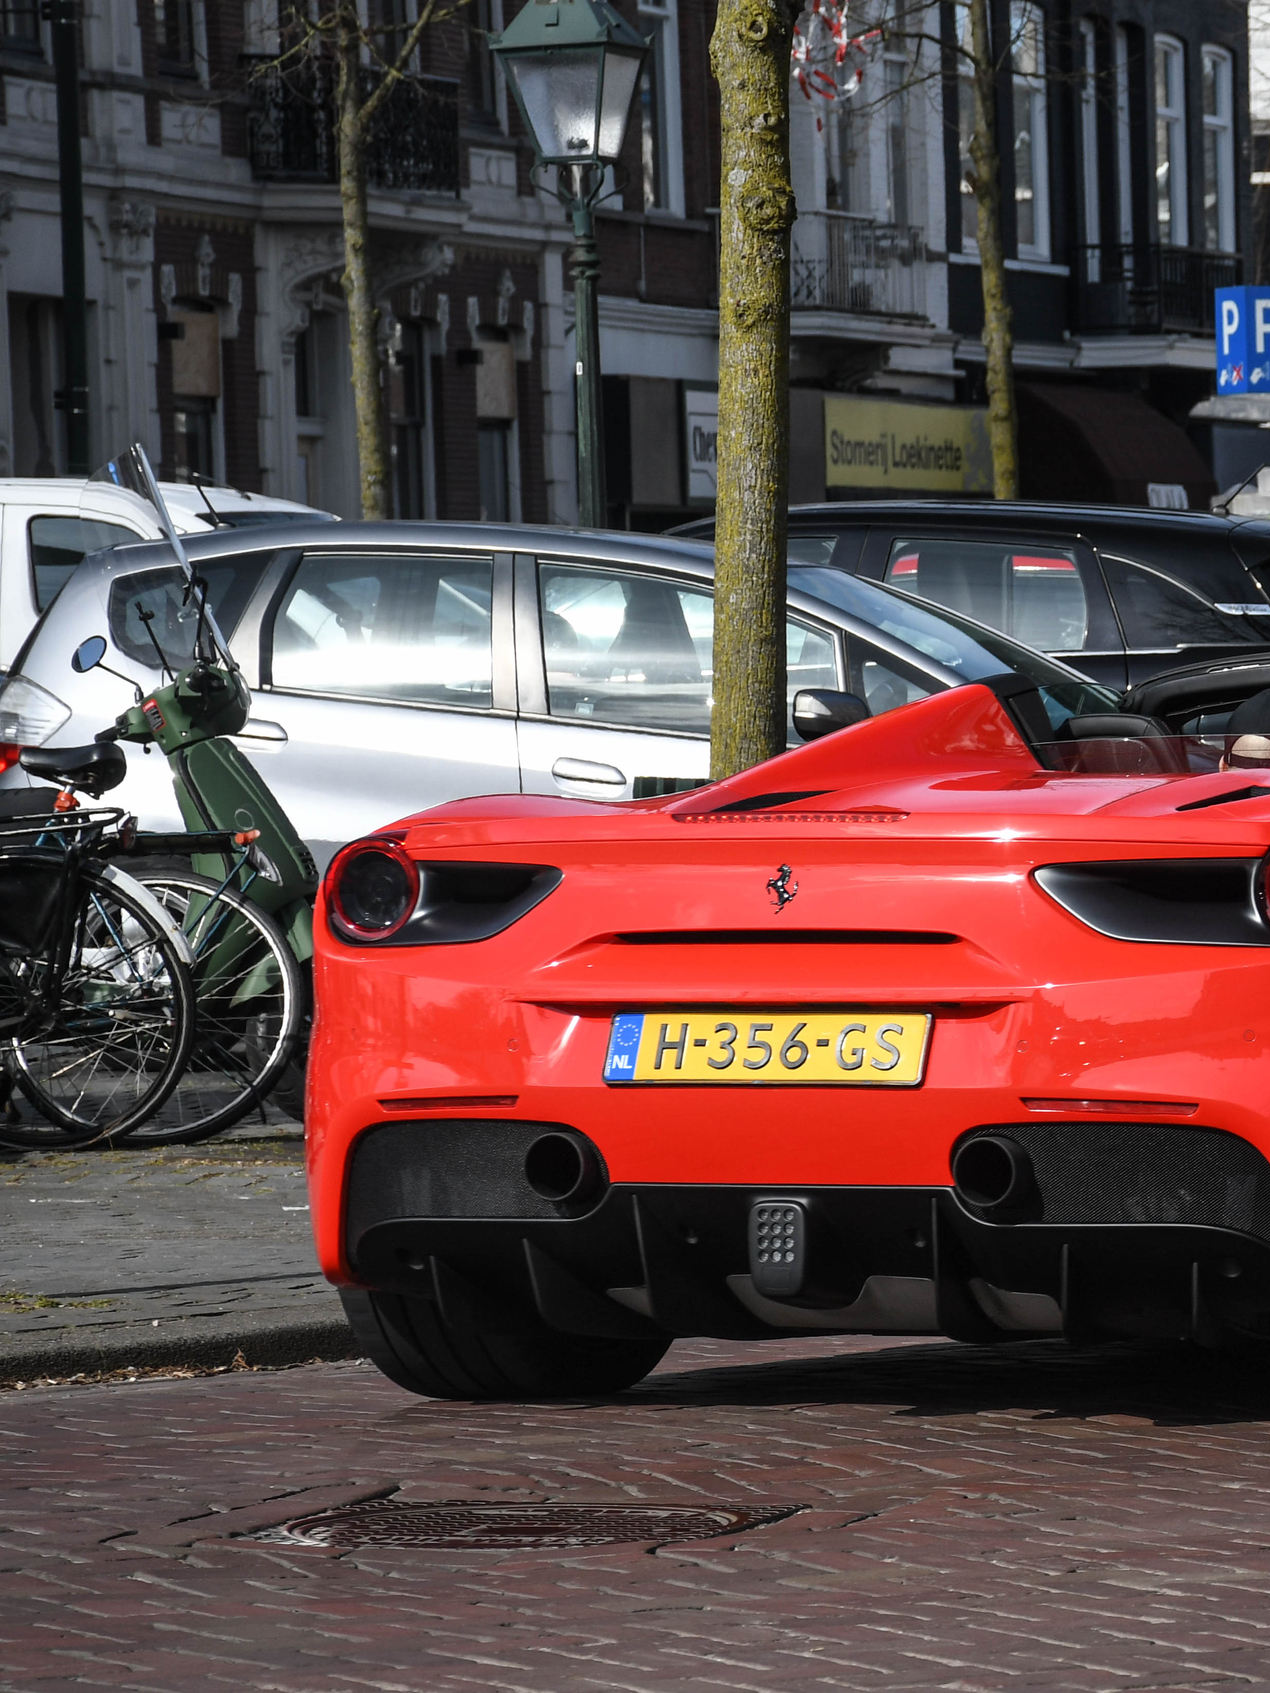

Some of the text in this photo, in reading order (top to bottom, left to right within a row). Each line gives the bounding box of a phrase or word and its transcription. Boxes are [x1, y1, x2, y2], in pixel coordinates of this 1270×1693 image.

[1222, 300, 1239, 355] P
[830, 428, 888, 475] Stomerij
[612, 1054, 633, 1069] NL
[654, 1022, 903, 1071] H-356-GS
